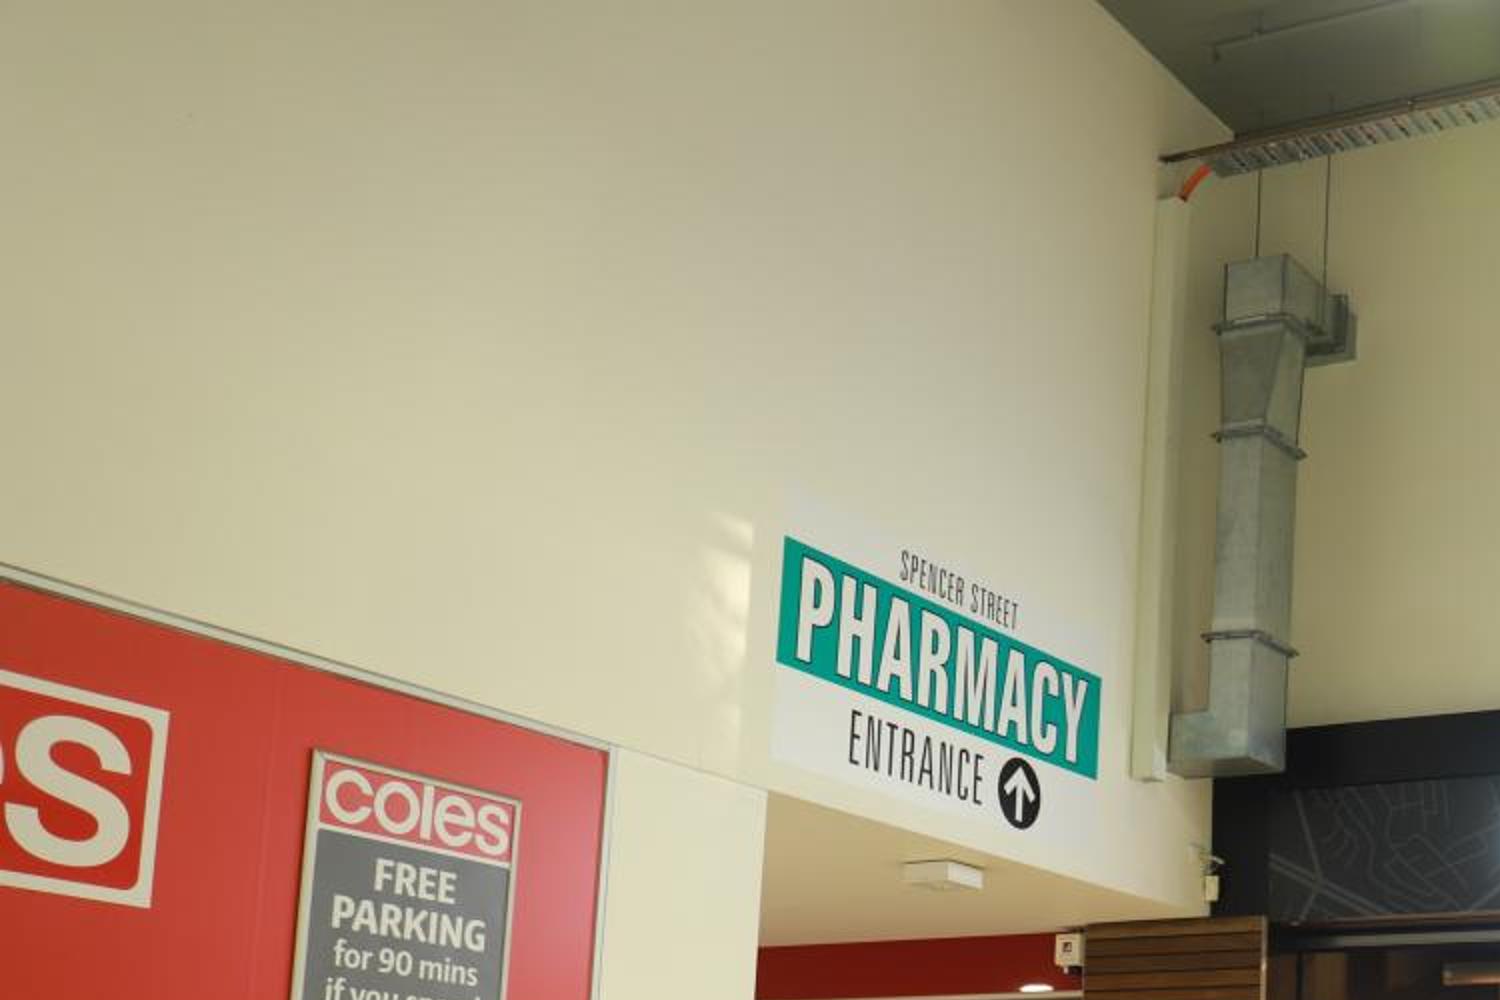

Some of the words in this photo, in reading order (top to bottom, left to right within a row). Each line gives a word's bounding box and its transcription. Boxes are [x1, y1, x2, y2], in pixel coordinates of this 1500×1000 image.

[900, 550, 965, 606] SPENCER
[970, 583, 1019, 631] STREET
[795, 556, 1089, 764] PHARMACY
[0, 714, 133, 868] s
[848, 709, 985, 806] ENTRANCE
[325, 768, 510, 856] coles
[330, 894, 486, 951] PARKING
[373, 857, 457, 905] FREE
[333, 938, 373, 971] for
[378, 947, 413, 977] 90
[418, 957, 479, 987] mins
